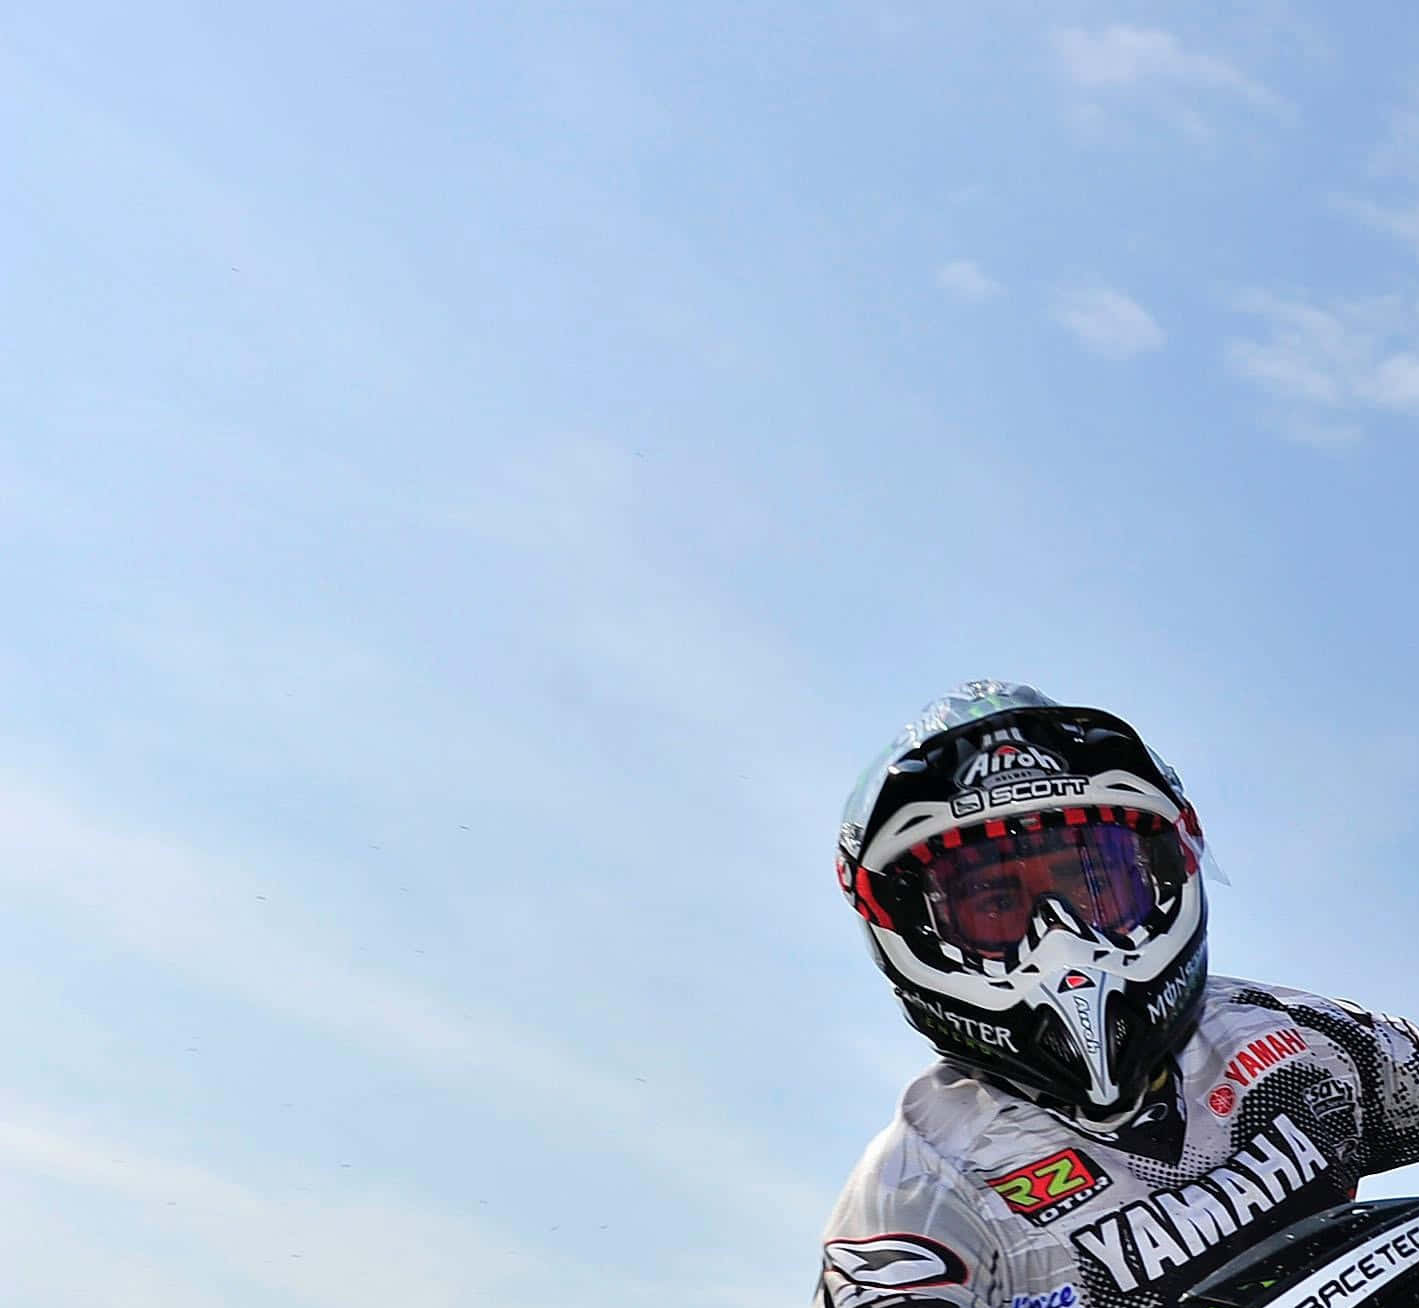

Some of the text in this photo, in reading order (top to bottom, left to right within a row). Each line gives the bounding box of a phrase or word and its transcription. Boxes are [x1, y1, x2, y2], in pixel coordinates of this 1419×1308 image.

[963, 746, 1062, 785] Airoh
[990, 778, 1087, 806] SCOTT
[1224, 1029, 1308, 1087] YAMAH
[993, 1158, 1086, 1206] RZ
[1075, 1113, 1329, 1293] YAMAHA
